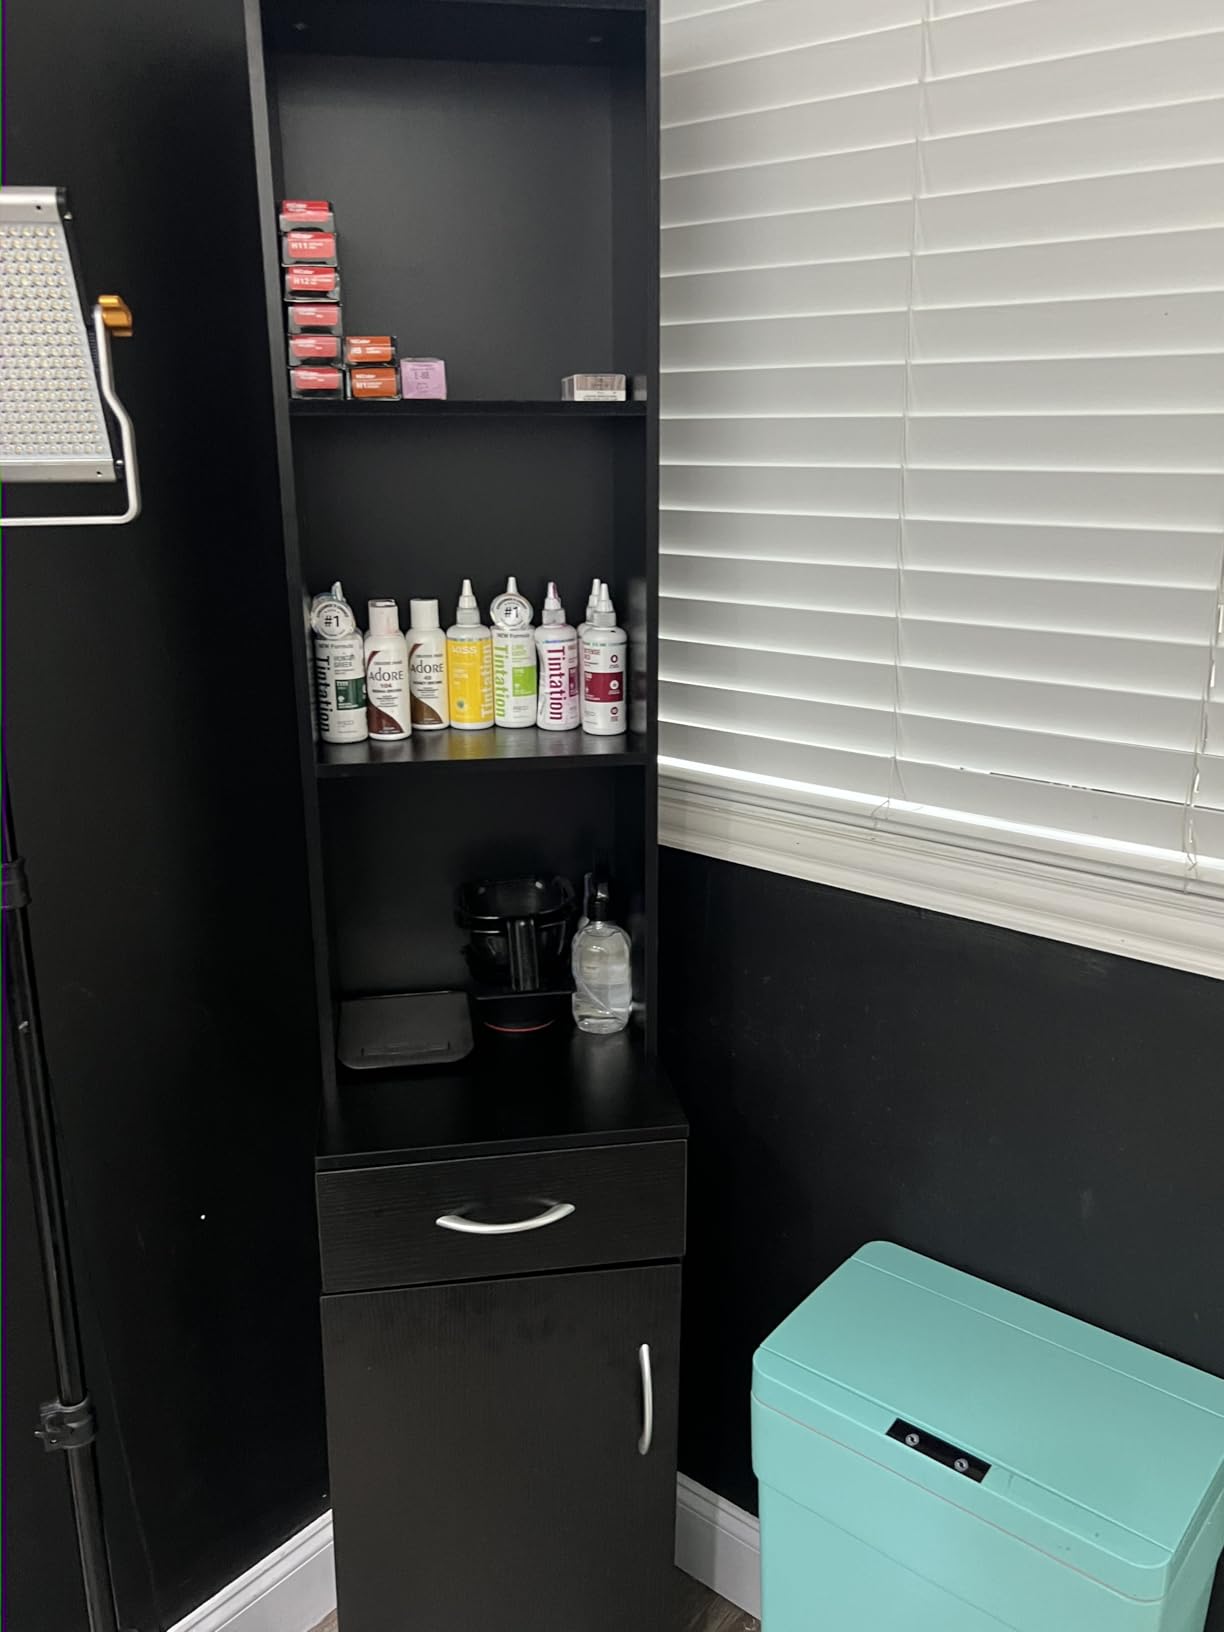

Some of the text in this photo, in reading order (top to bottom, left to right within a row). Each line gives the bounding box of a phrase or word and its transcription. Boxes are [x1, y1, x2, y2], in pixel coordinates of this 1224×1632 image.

[324, 615, 340, 628] #1
[504, 605, 520, 619] #1
[314, 655, 334, 732] Tintation
[494, 645, 510, 718] Tintation
[547, 645, 567, 721] Tintation
